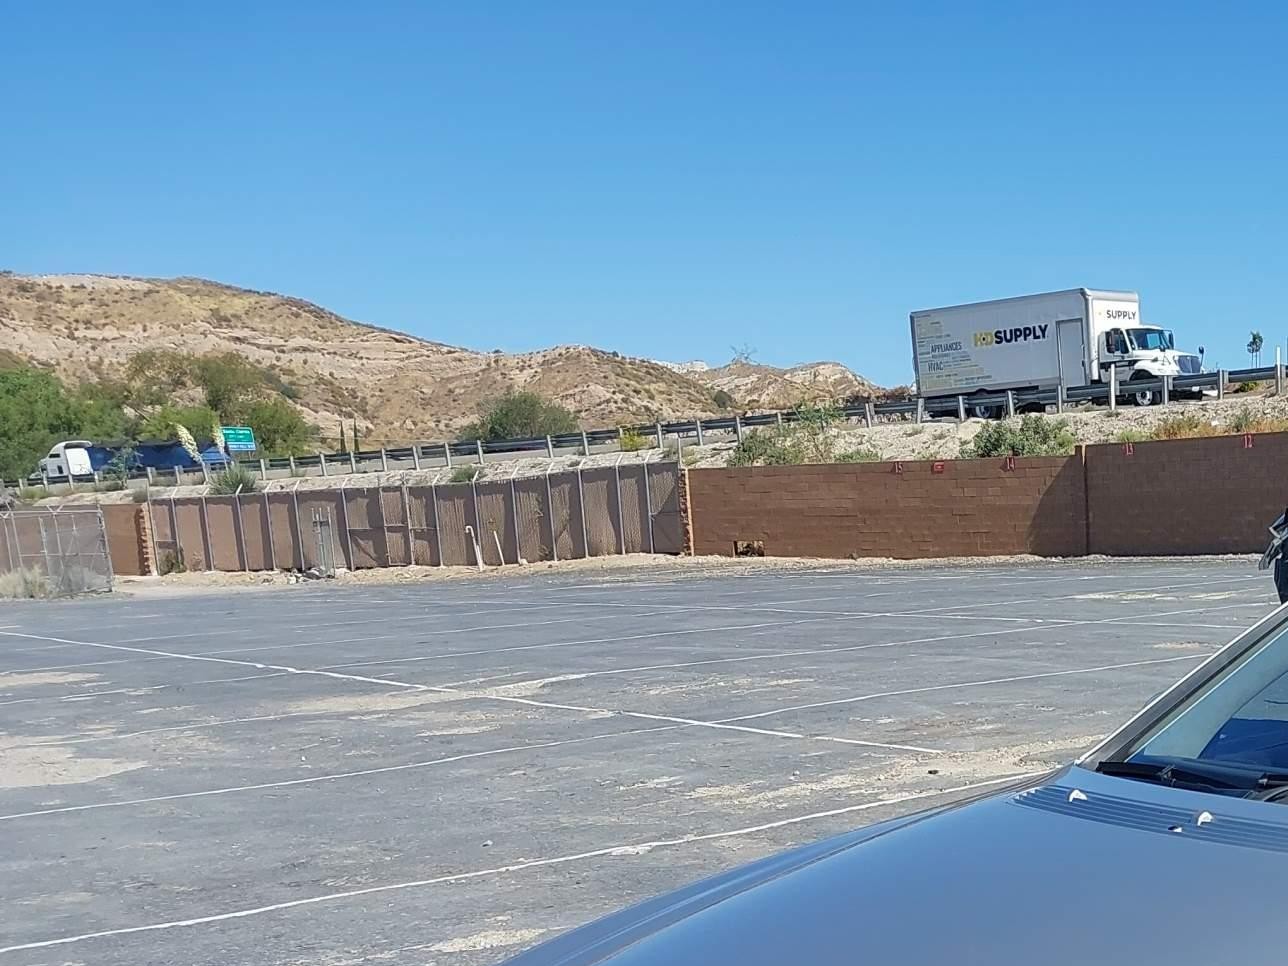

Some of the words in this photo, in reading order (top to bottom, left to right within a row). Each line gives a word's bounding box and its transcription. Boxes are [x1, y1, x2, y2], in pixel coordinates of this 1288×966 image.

[1106, 308, 1136, 321] SUPPLY
[994, 323, 1049, 345] SUPPLY
[930, 340, 963, 354] APPLIANCES
[927, 361, 944, 373] HVAC
[1244, 434, 1253, 449] 12
[894, 461, 903, 473] 15
